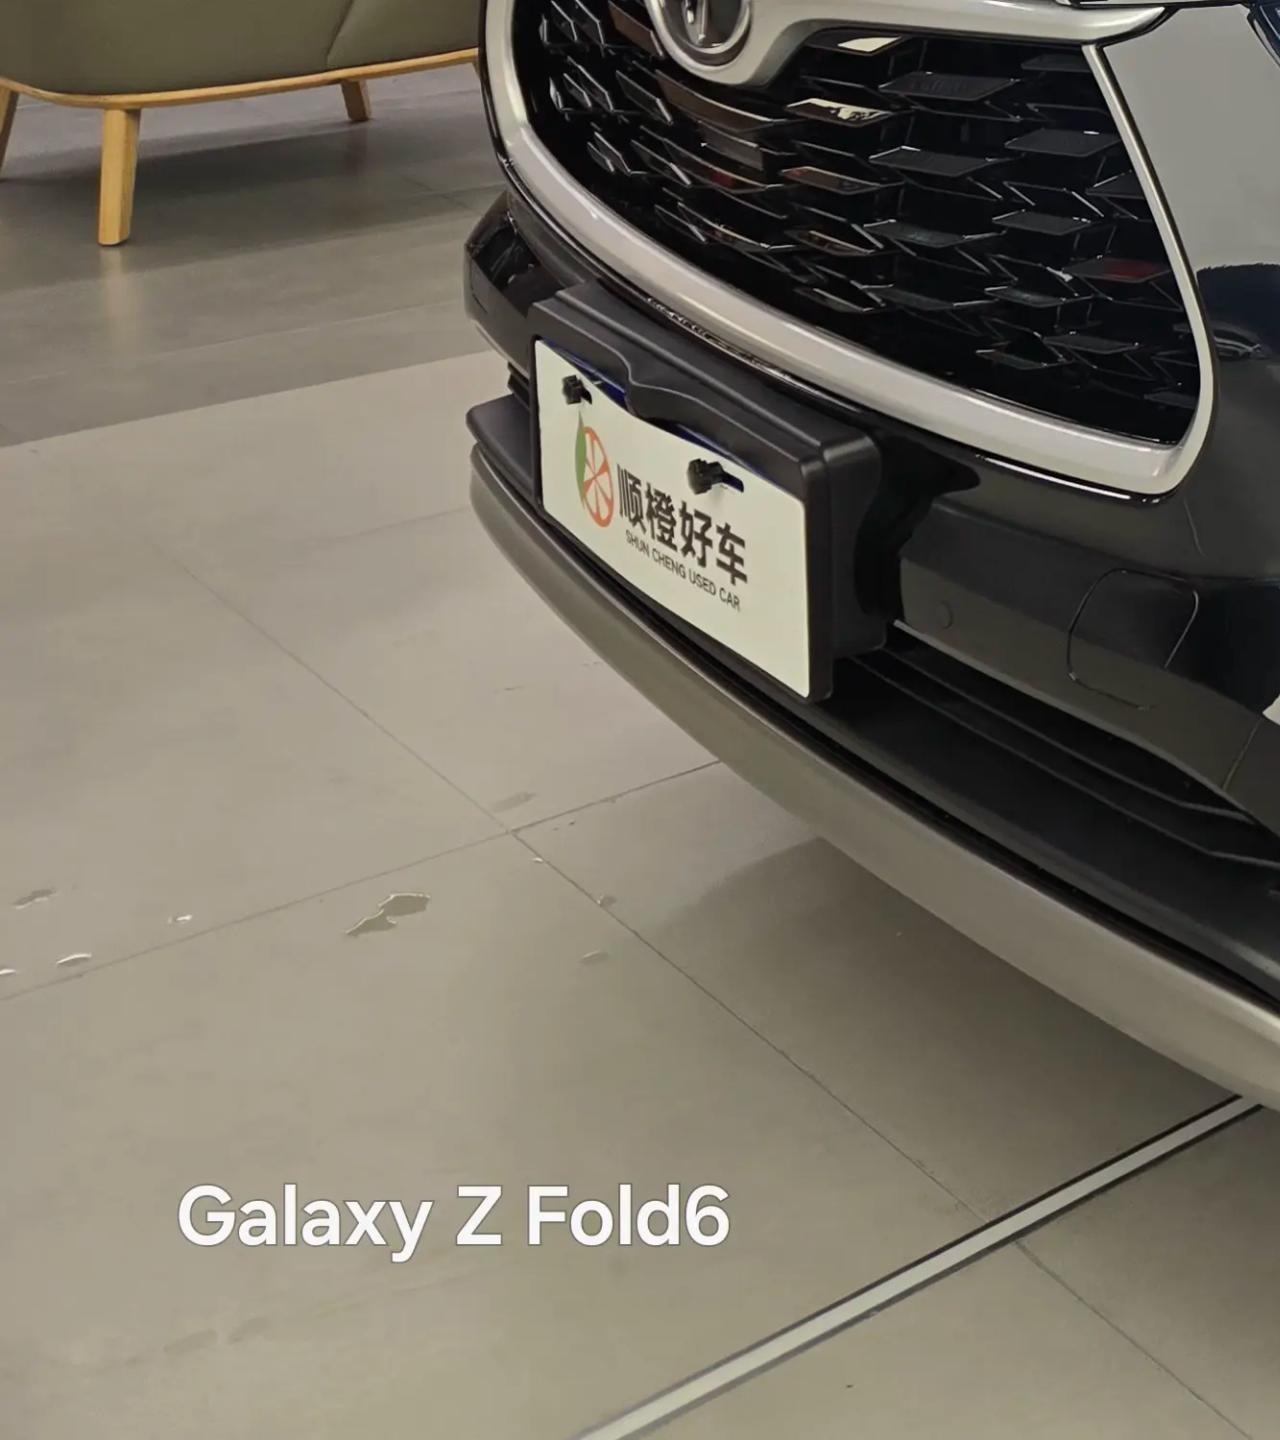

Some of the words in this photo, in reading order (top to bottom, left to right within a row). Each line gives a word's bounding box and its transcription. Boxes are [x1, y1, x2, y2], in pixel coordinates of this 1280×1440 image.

[616, 463, 748, 587] 顺橙好车
[625, 528, 650, 559] SHUN
[652, 548, 686, 580] CHENG
[688, 569, 717, 597] USED
[719, 587, 741, 612] CAR
